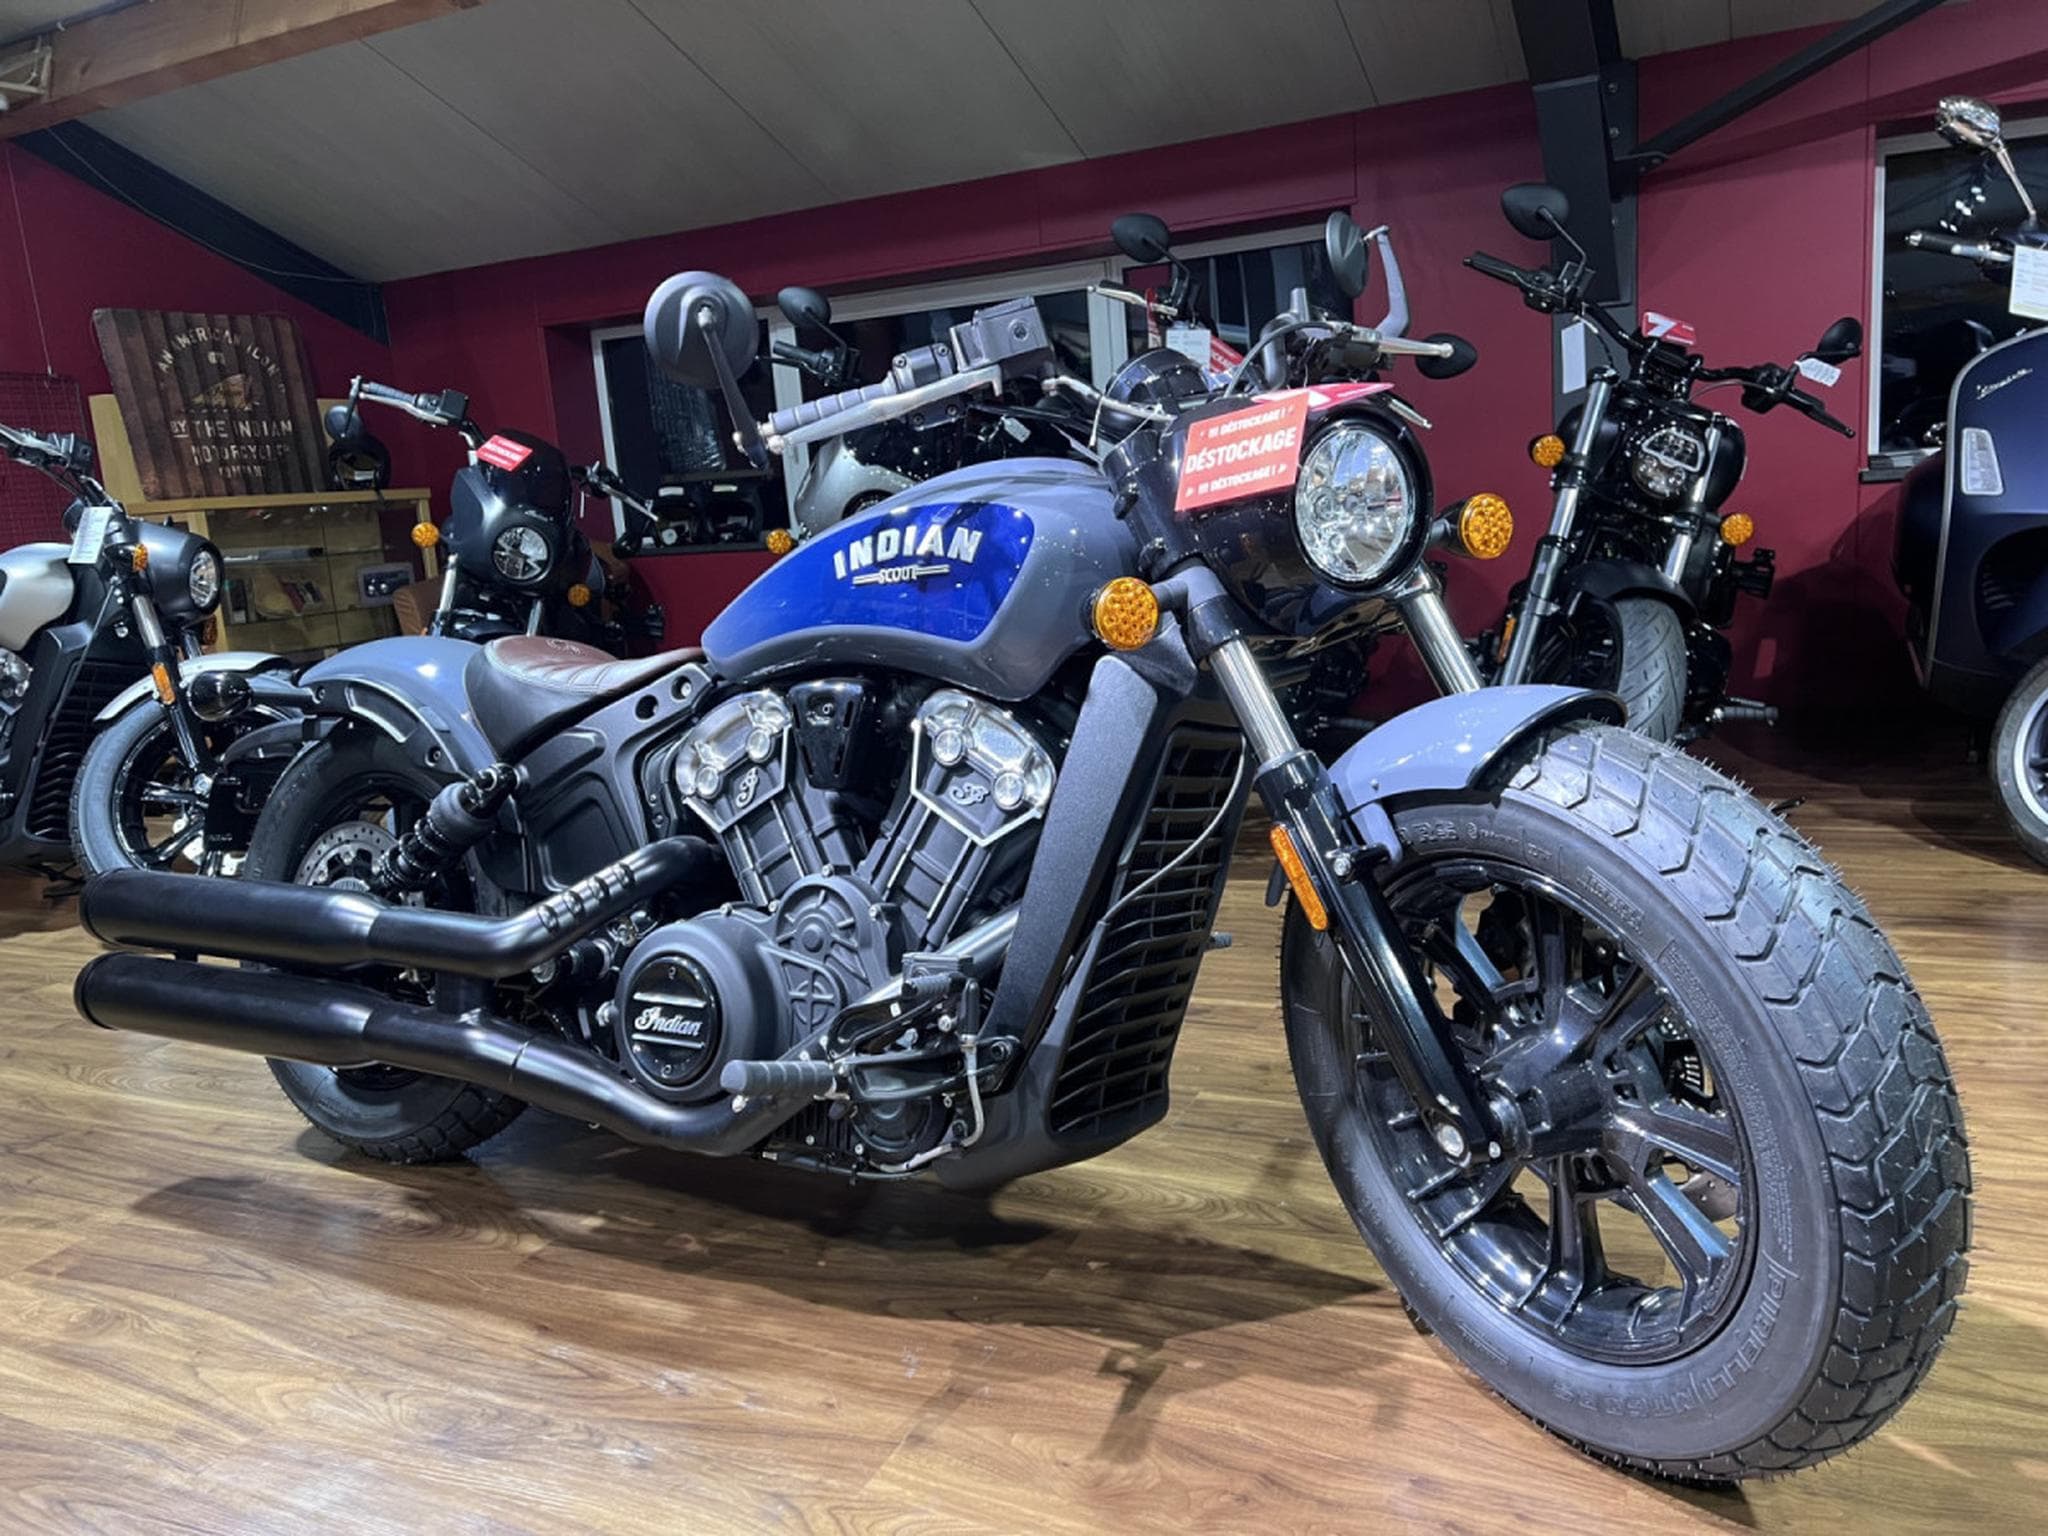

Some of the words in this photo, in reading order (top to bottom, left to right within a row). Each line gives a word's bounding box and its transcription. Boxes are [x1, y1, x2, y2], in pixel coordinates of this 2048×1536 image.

[158, 348, 175, 373] AN
[192, 420, 229, 438] THE
[233, 419, 293, 438] INDIAN
[1184, 427, 1297, 475] DÉSTOCKAGE
[833, 523, 983, 580] INDIAN
[878, 564, 919, 584] SCOUT
[634, 1006, 703, 1036] Indian
[1702, 1262, 1786, 1400] PIRELLI
